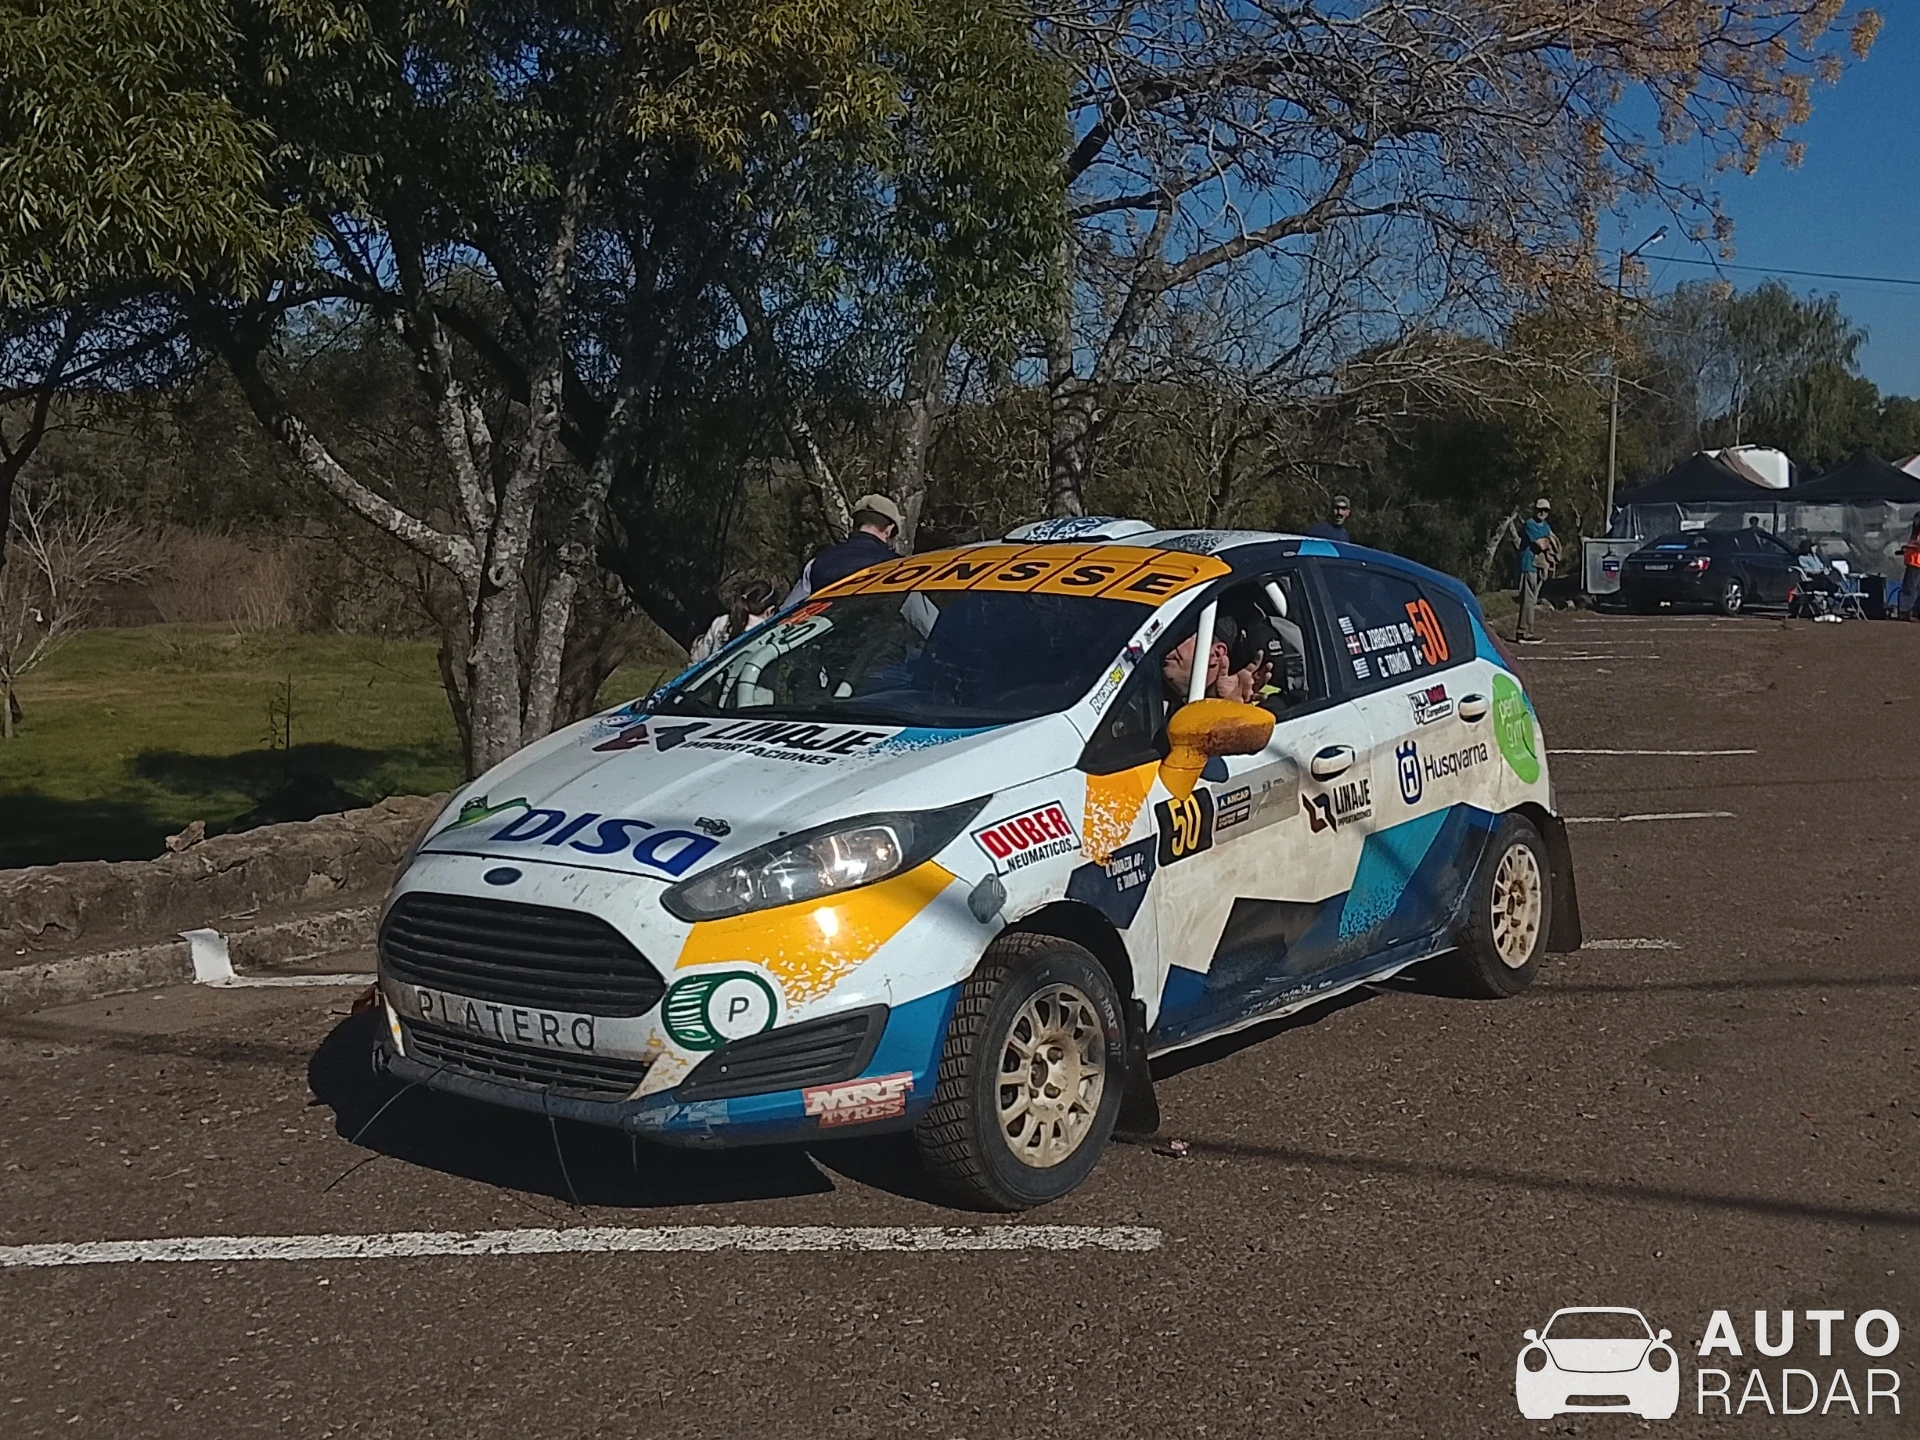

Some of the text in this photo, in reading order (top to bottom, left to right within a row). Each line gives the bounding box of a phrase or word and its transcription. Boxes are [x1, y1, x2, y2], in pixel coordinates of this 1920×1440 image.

[826, 561, 1190, 596] PONSSE
[1405, 598, 1449, 666] 50
[682, 741, 838, 766] IMPORTACIONES
[700, 721, 889, 755] LINAJE
[1424, 743, 1488, 782] Husqvarna
[1227, 789, 1249, 807] ANCAP
[1333, 779, 1371, 815] LINAJE
[980, 807, 1072, 859] DUBER
[1167, 793, 1201, 856] 50
[1006, 838, 1072, 872] NEUMATICOS
[416, 989, 595, 1051] PLATERO
[728, 997, 750, 1022] P
[808, 1080, 914, 1113] MRF
[820, 1101, 899, 1123] TYRES
